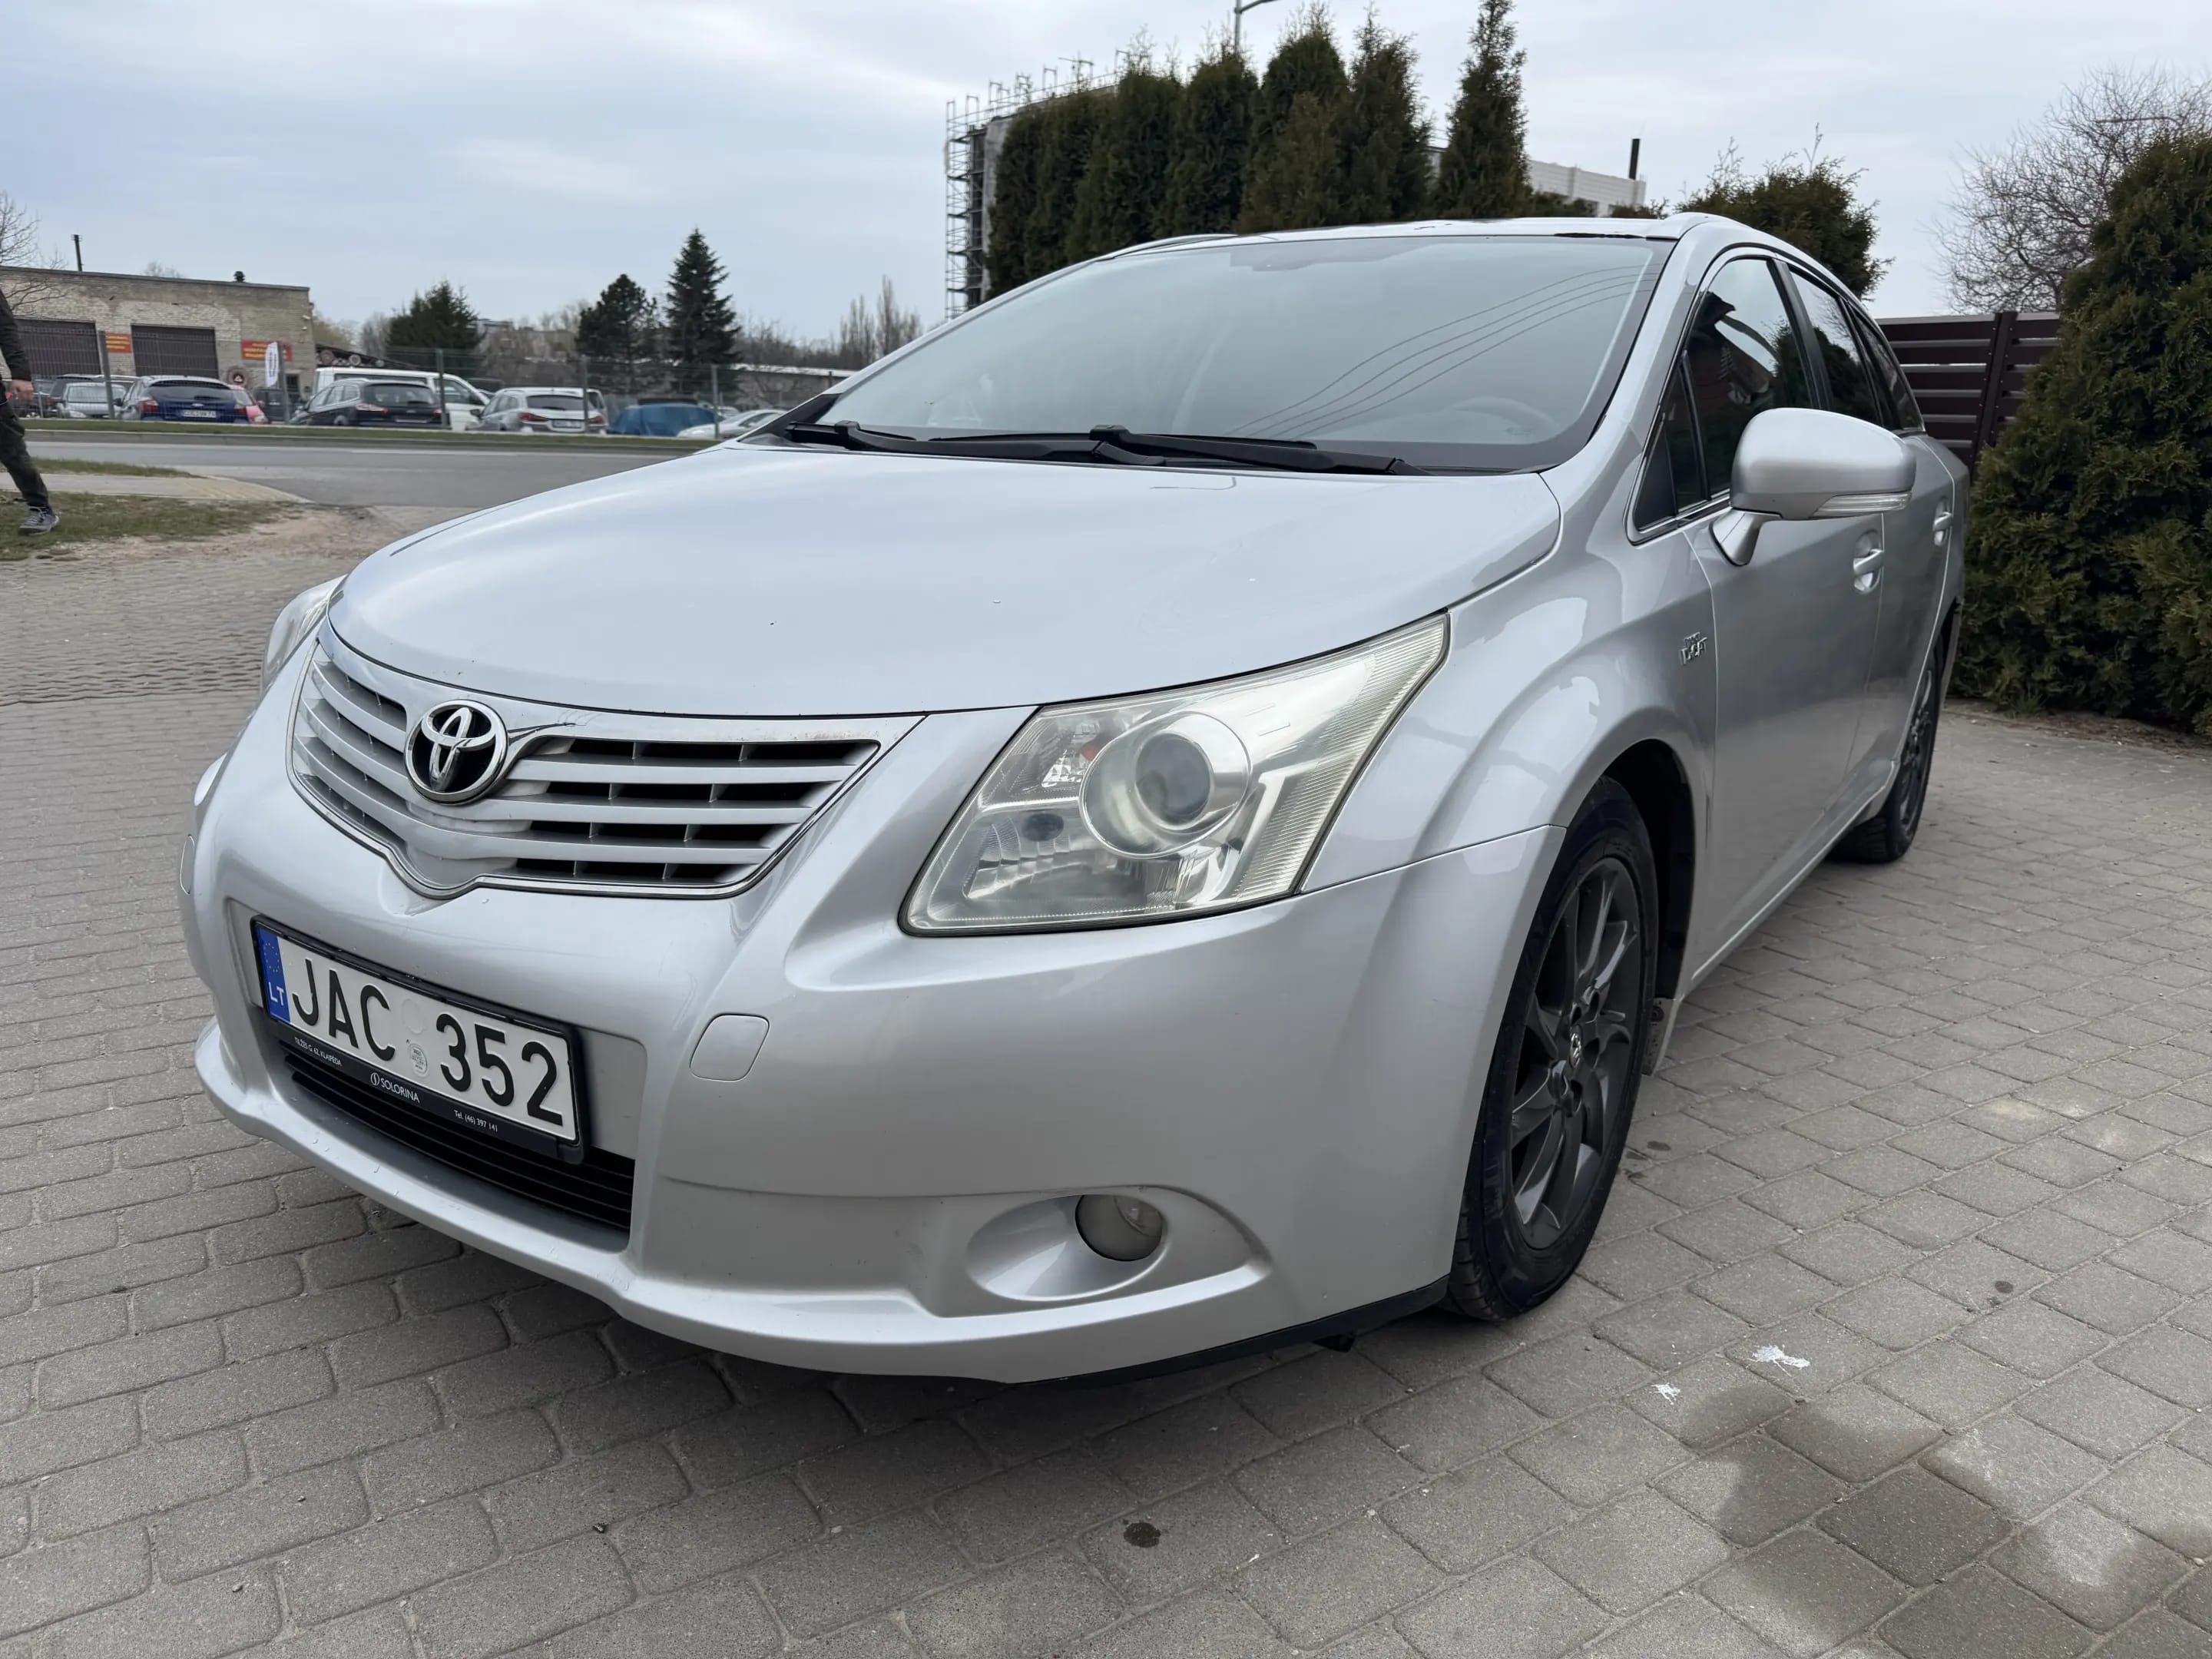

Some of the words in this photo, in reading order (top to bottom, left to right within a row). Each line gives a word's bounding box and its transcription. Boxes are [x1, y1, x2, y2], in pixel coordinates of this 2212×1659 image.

[268, 982, 284, 1006] LT
[292, 958, 396, 1061] JAC
[435, 1014, 563, 1127] 352
[380, 1078, 420, 1104] SOLORINA
[476, 1118, 487, 1128] 397
[488, 1122, 498, 1132] 141
